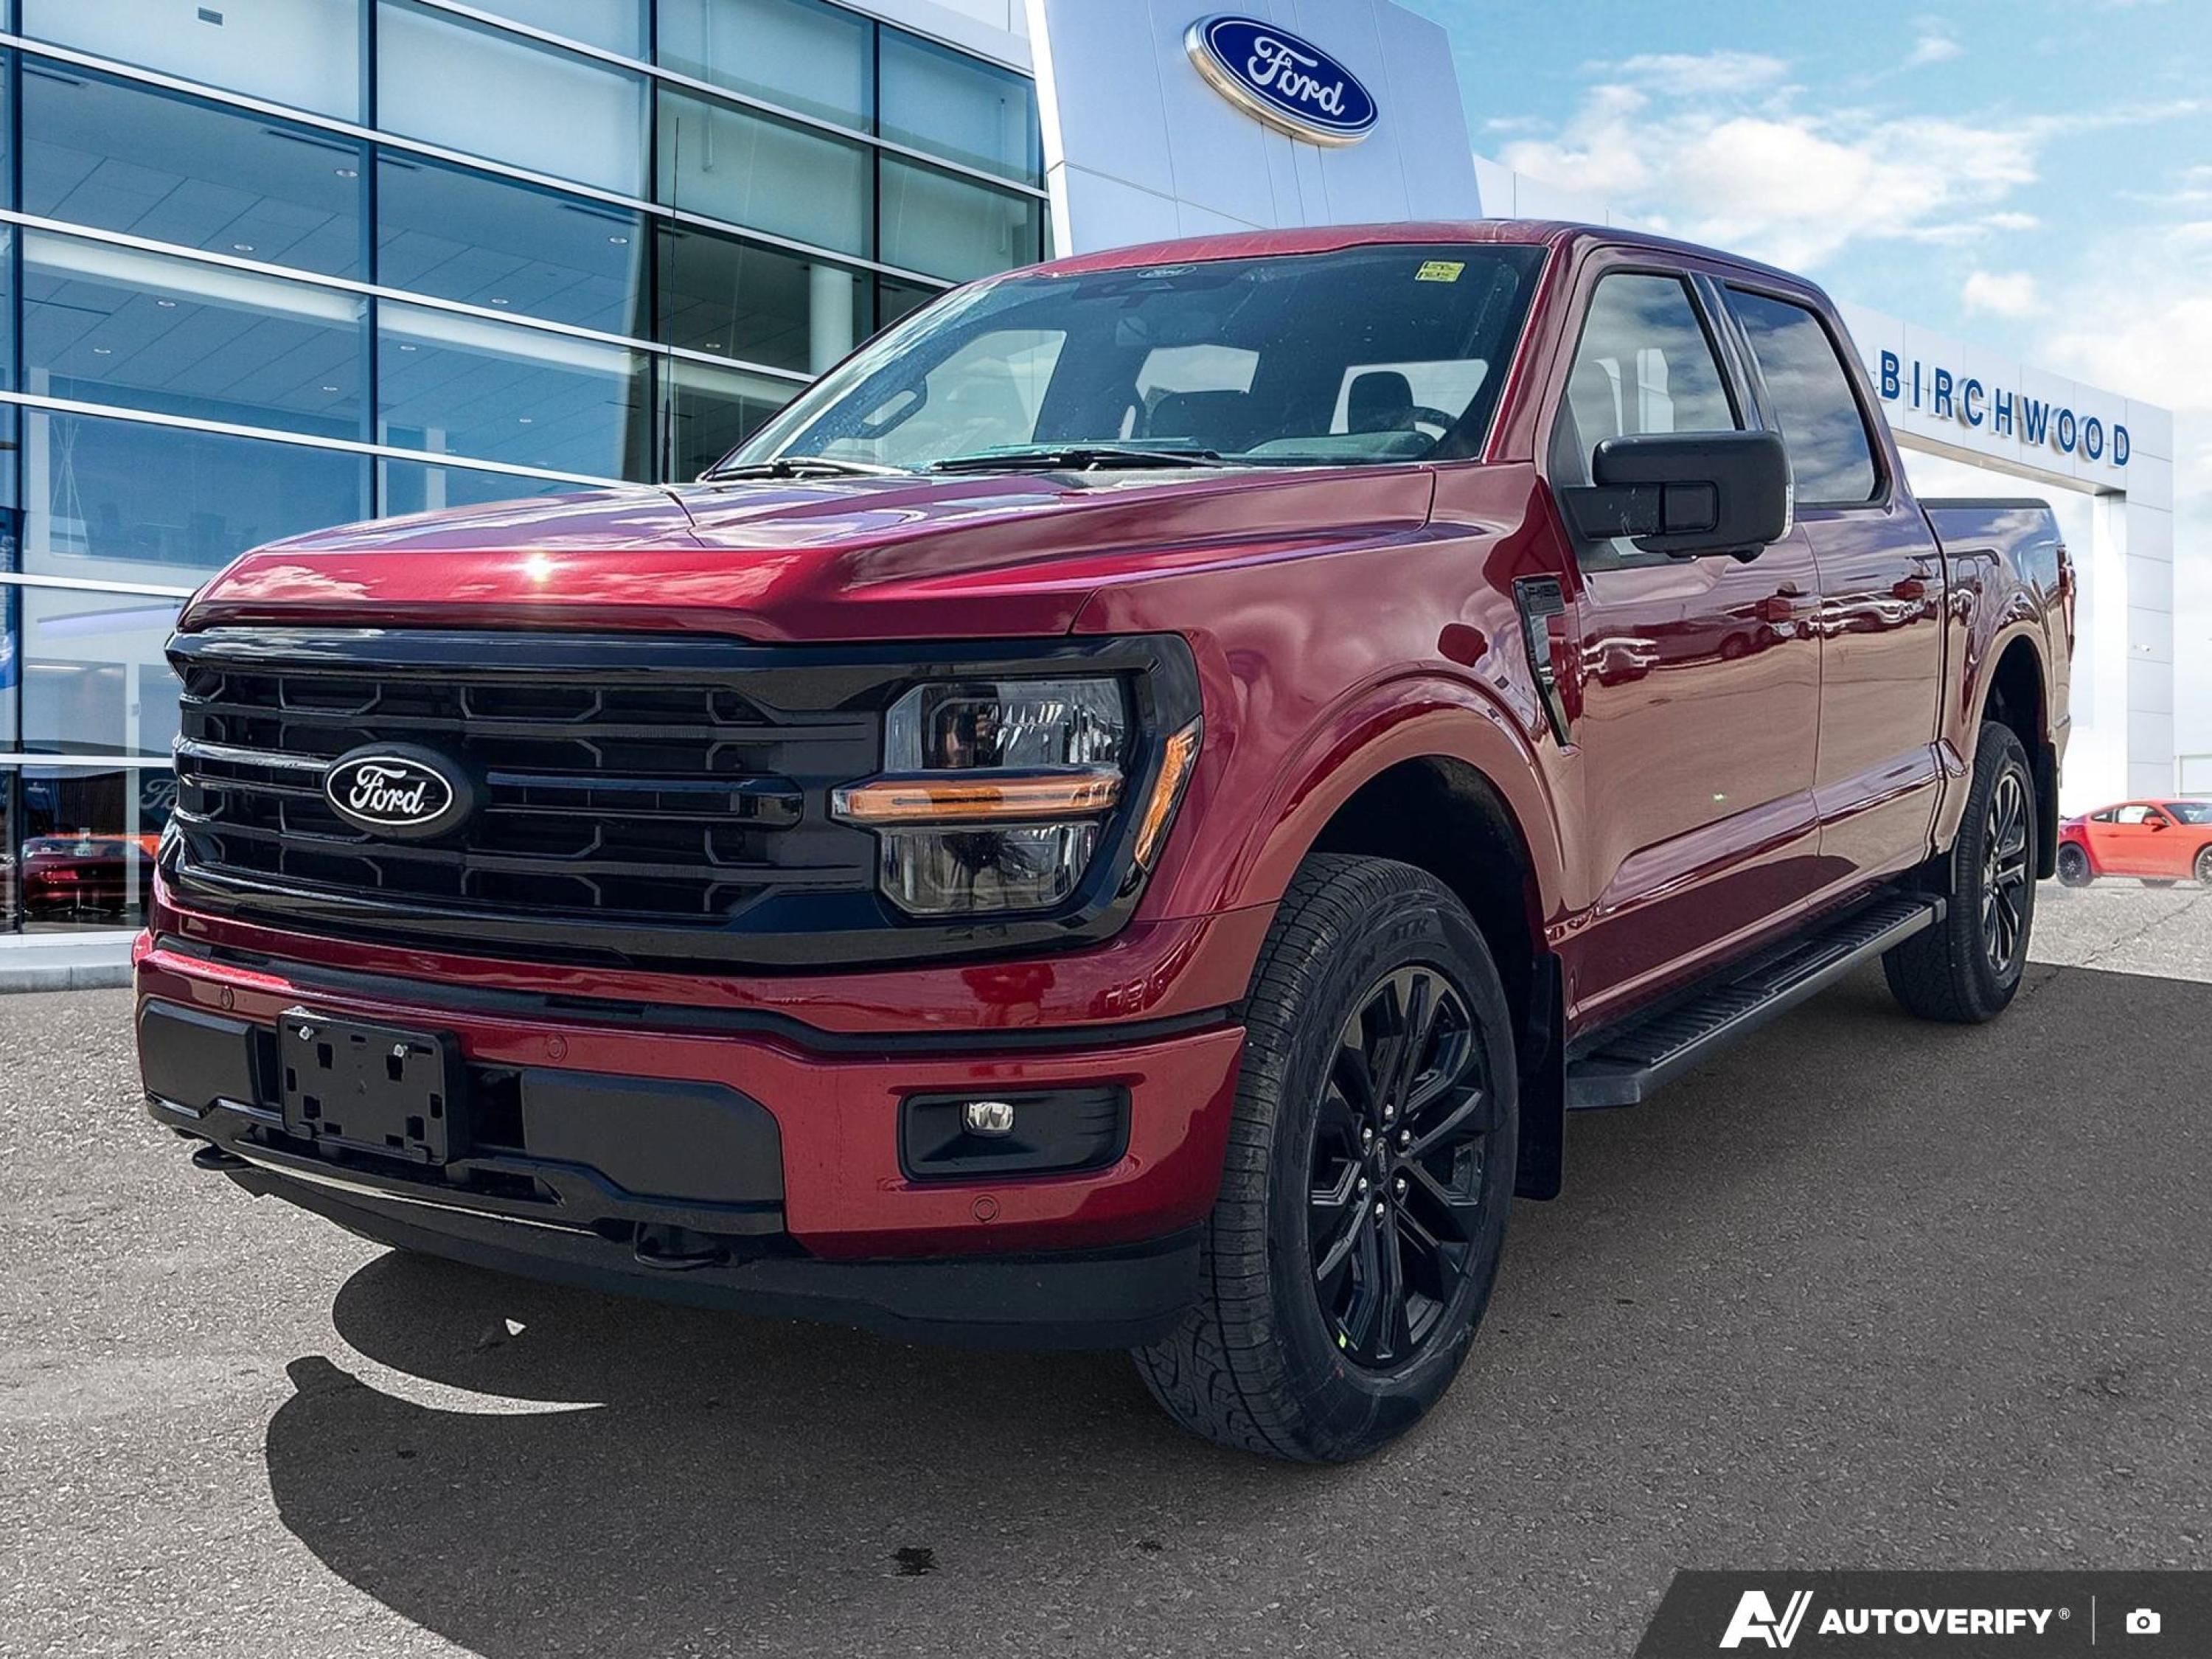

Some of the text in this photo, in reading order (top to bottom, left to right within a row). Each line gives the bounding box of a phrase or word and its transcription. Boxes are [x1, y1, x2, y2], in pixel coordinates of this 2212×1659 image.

[1248, 36, 1345, 116] Ford
[1881, 349, 2130, 466] BIRCHWOOD
[349, 765, 426, 815] Ford
